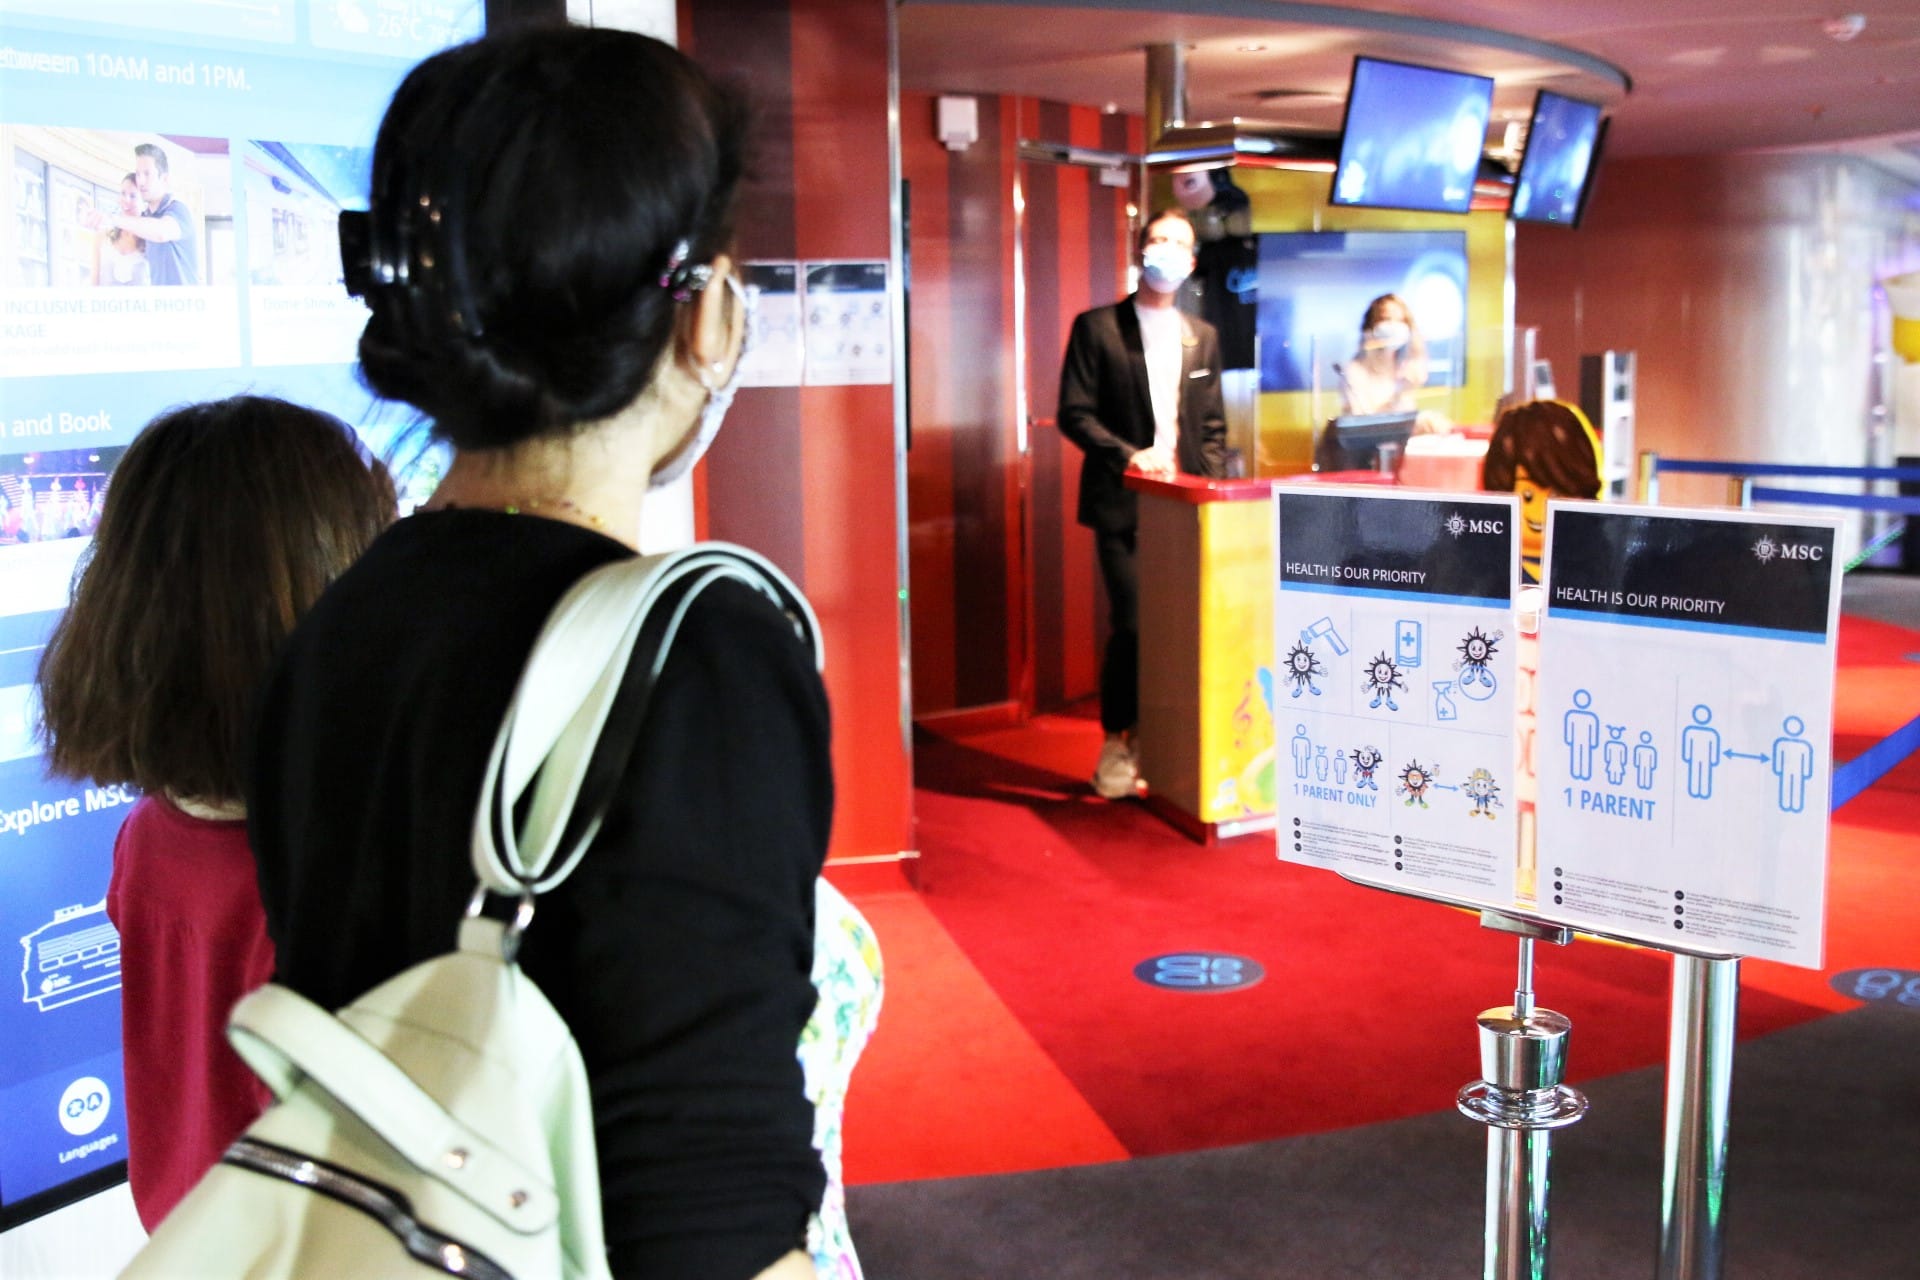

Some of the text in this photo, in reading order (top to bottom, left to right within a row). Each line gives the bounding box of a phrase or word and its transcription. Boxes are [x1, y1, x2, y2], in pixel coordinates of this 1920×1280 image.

[85, 52, 149, 80] 10AM
[154, 62, 197, 85] and
[202, 64, 252, 91] 1PM.
[5, 298, 206, 314] INCLUSIVE DIGITAL PHOTO
[12, 412, 52, 437] and
[59, 409, 112, 433] Book
[1468, 518, 1504, 535] MSC
[1780, 543, 1823, 561] MSC
[1286, 562, 1426, 584] HEALTH IS OUR PRIORITY
[1556, 587, 1726, 615] HEALTH IS OUR PRIORITY
[1294, 783, 1377, 808] 1 PARENT ONLY
[1563, 787, 1656, 822] 1 PARENT
[59, 1132, 119, 1164] Languages
